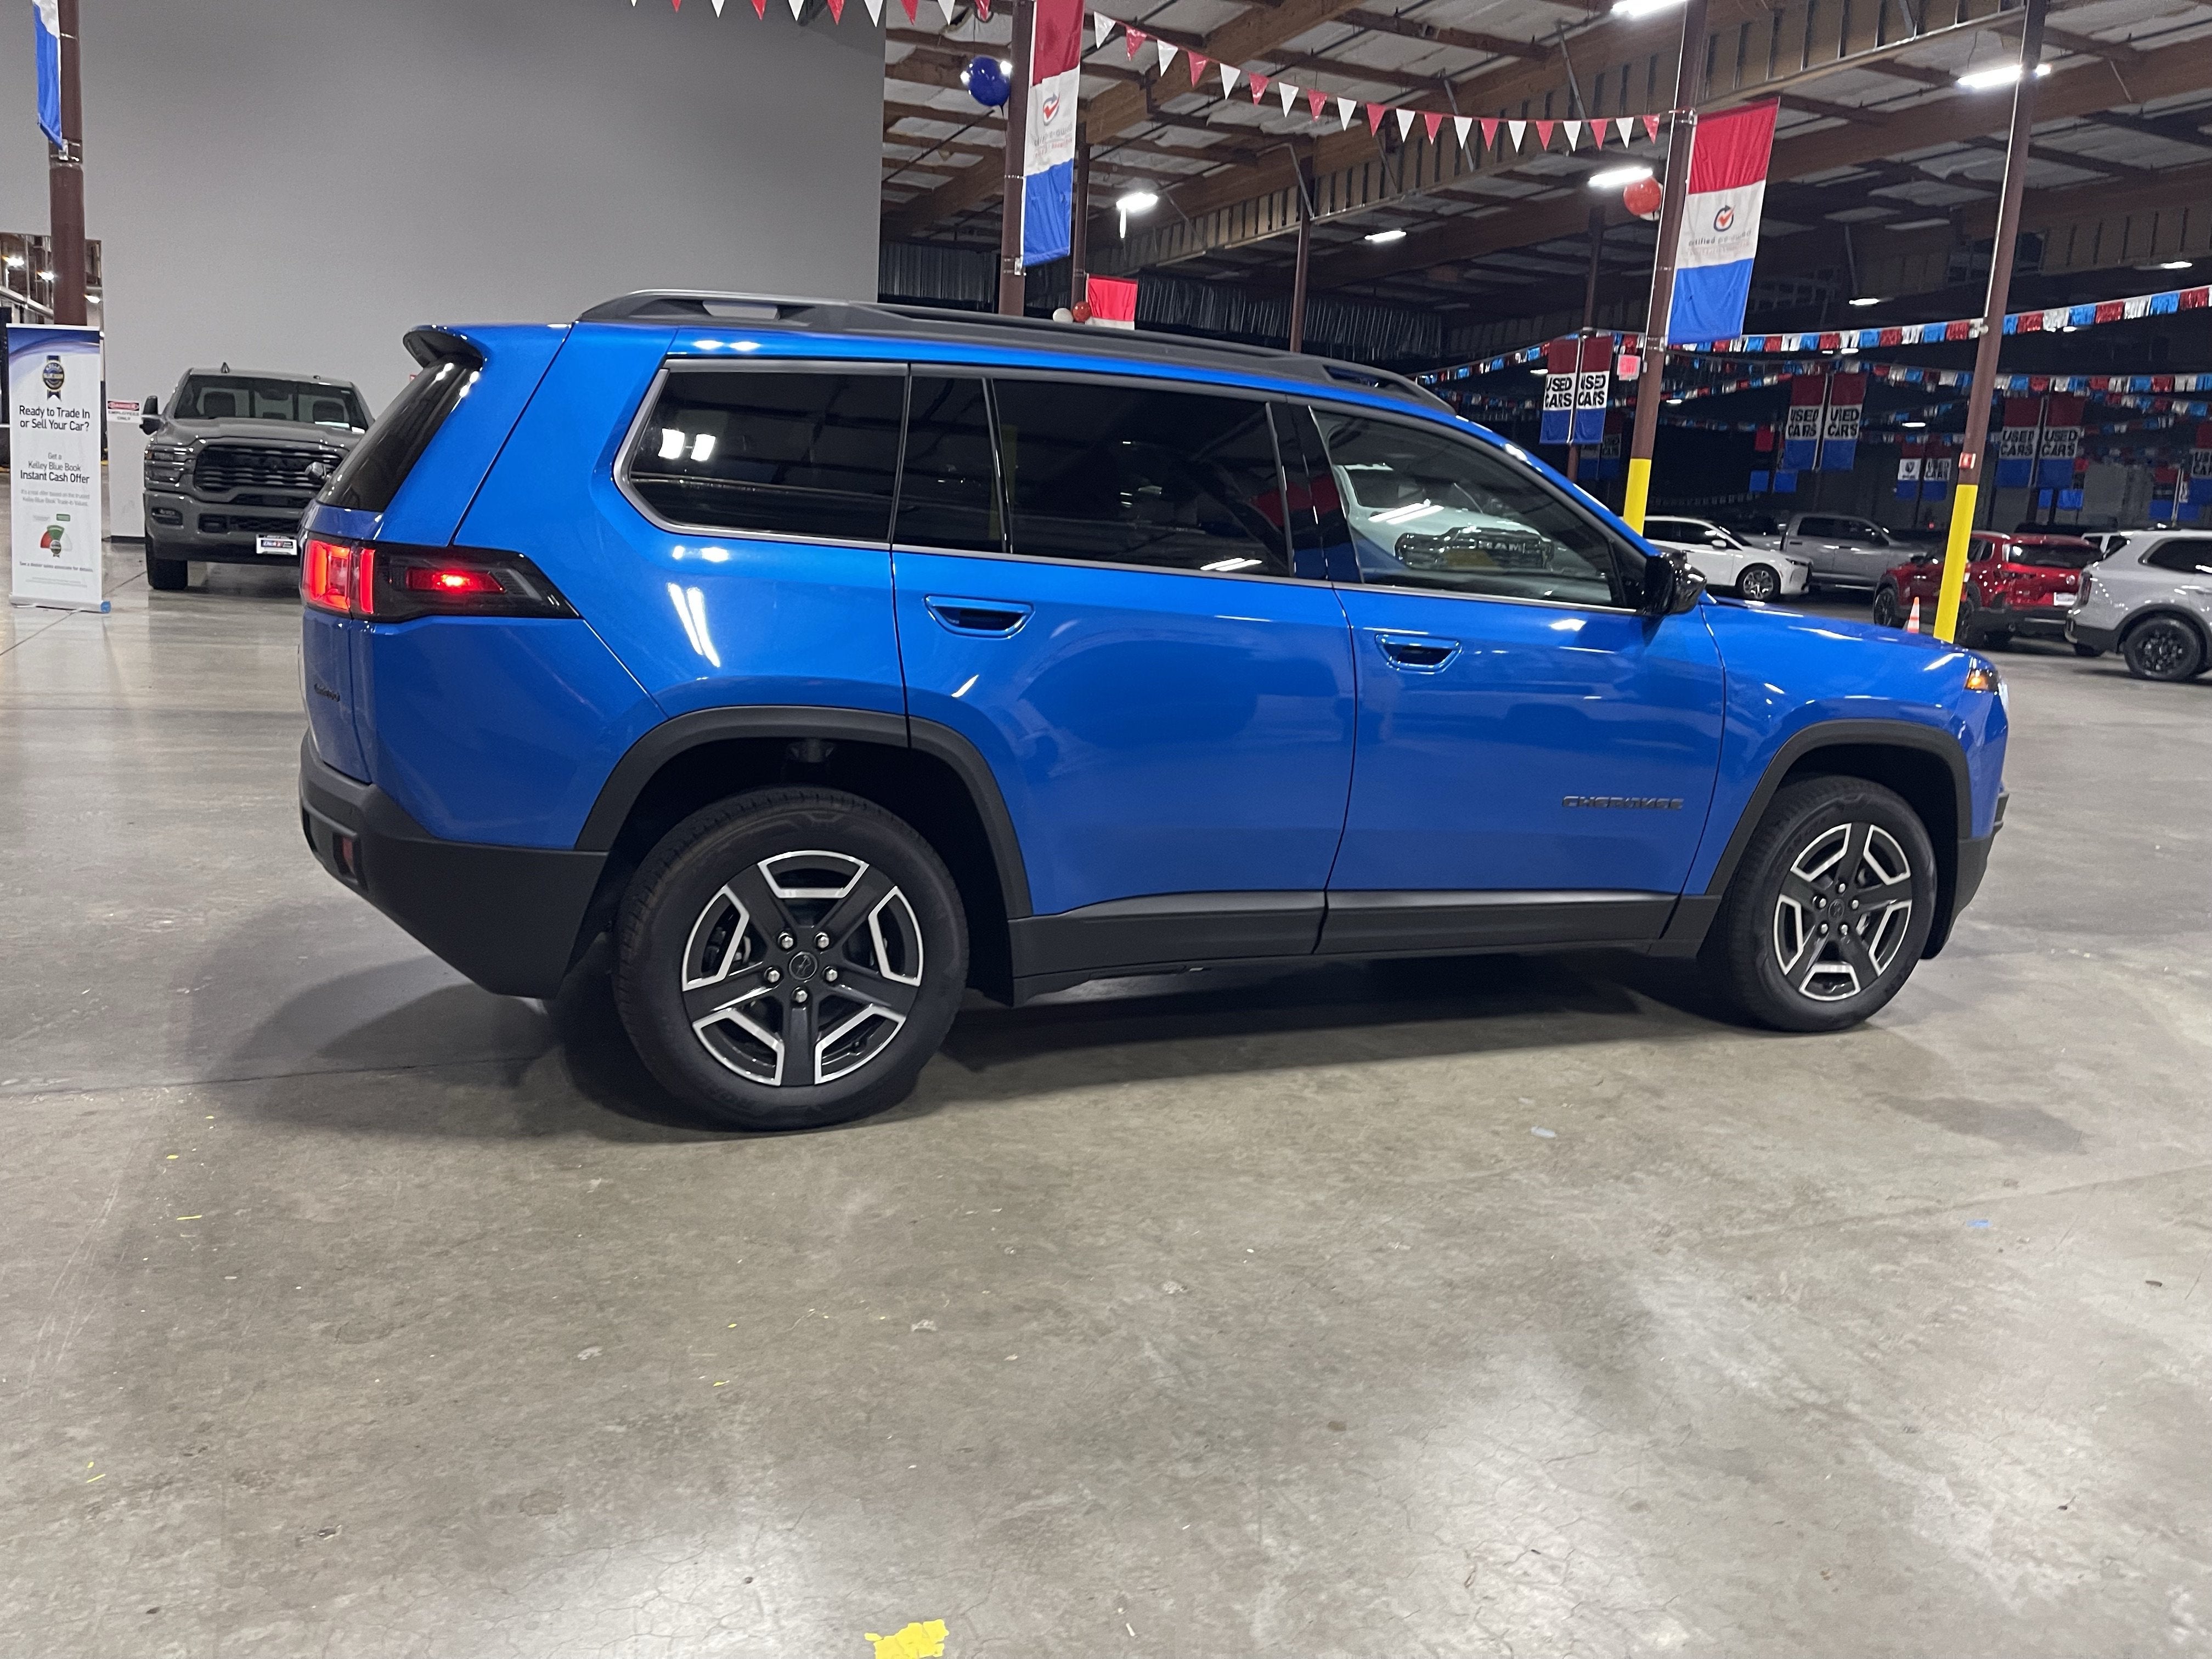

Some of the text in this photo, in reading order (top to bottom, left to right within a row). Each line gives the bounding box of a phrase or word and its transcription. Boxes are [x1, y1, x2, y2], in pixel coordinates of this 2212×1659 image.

[1547, 377, 1572, 392] USED
[1581, 375, 1606, 390] USED
[1545, 393, 1572, 408] CARS
[1578, 391, 1605, 406] CARS
[20, 405, 90, 419] Ready to Trade In
[1791, 409, 1819, 422] USED
[32, 419, 47, 429] Sell
[49, 420, 67, 430] Your
[70, 421, 89, 431] Car?
[1788, 424, 1816, 437] CARS
[1827, 424, 1858, 437] CARS
[28, 460, 81, 471] Kelley Blue Book
[21, 470, 90, 483] Instant Cash Offer
[1562, 795, 1684, 810] CHEROKEE
